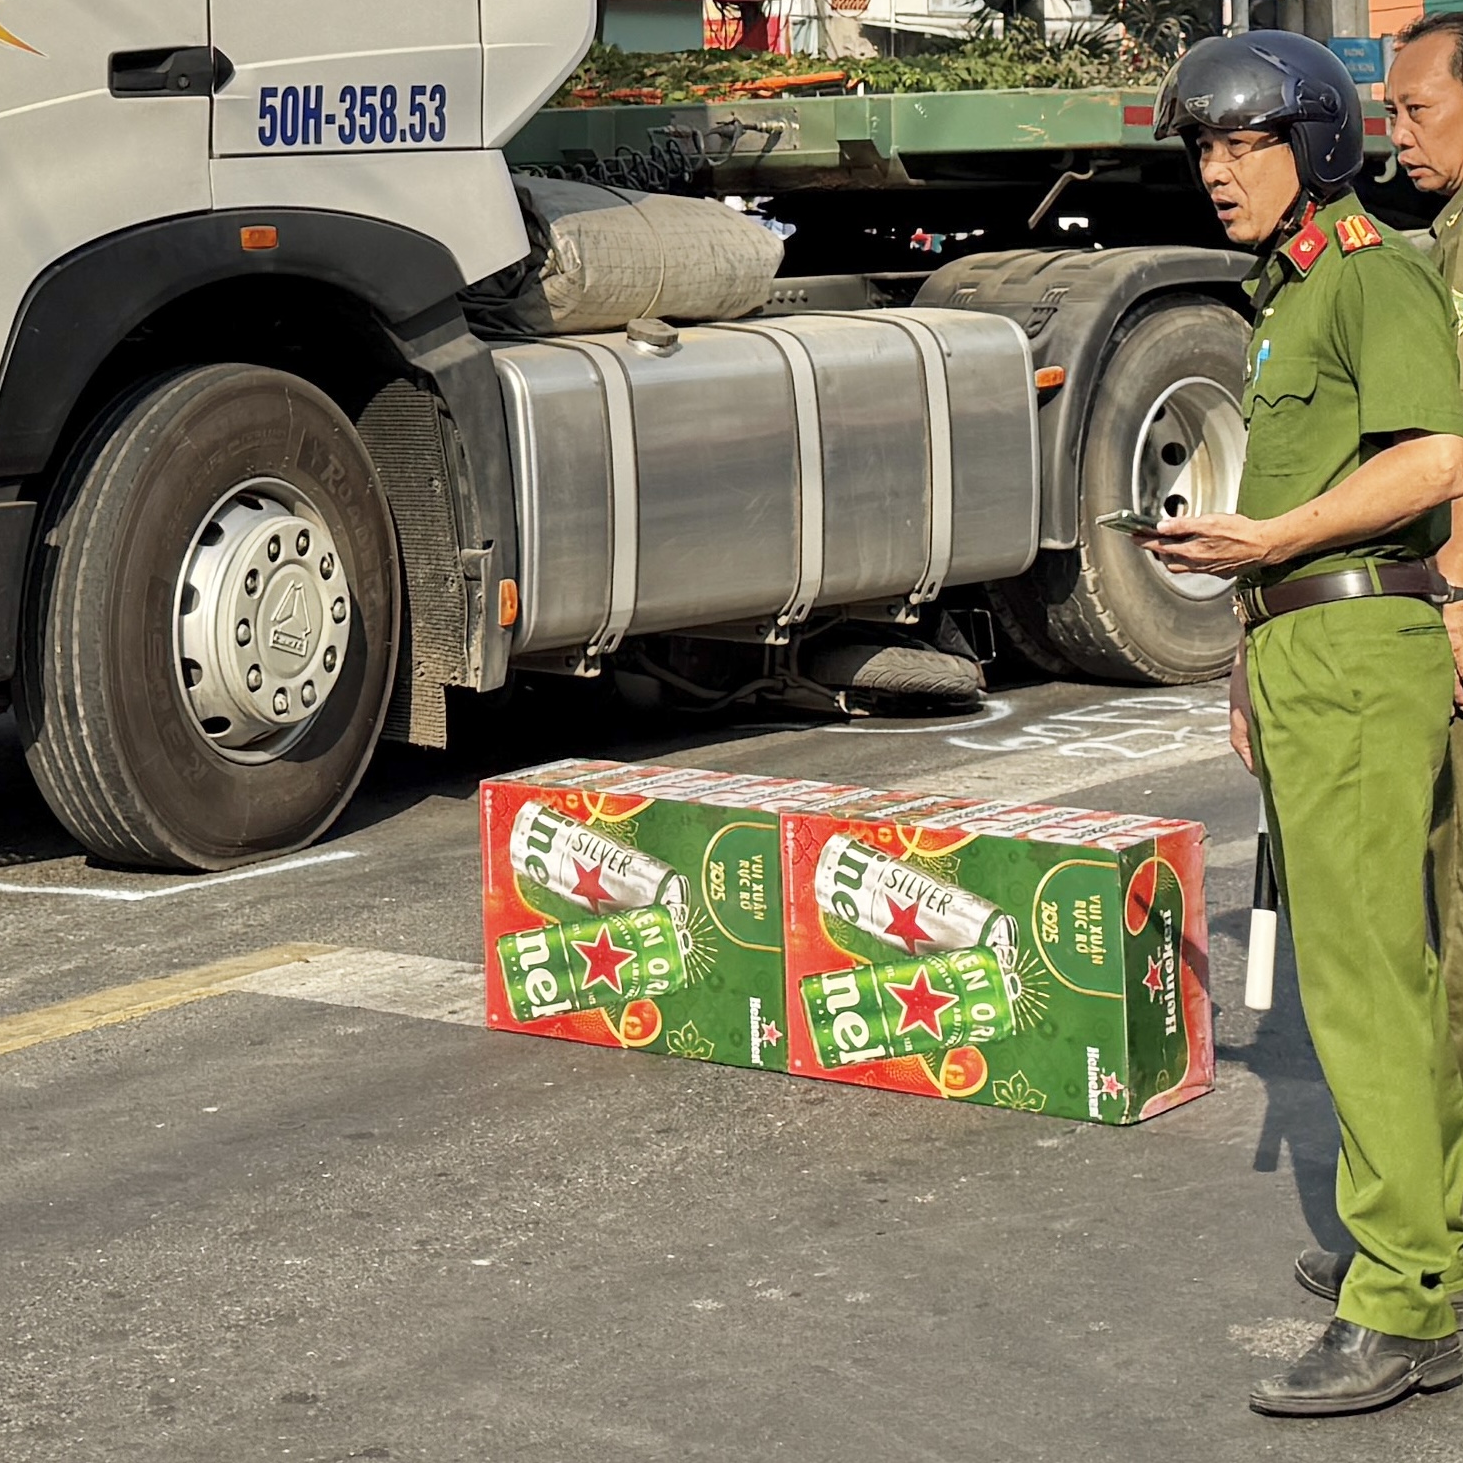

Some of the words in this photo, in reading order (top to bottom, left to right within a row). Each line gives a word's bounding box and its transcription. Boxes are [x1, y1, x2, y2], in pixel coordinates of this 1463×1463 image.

[258, 84, 447, 147] 50H-358.53
[571, 833, 633, 877] SILVER
[752, 854, 764, 879] VUI
[709, 861, 726, 902] 2025
[885, 868, 953, 916] SILVER
[1041, 901, 1059, 944] 2025
[1089, 894, 1101, 921] VUI
[1159, 909, 1178, 1037] Heineken
[749, 996, 764, 1066] Heineken
[1087, 1046, 1103, 1120] Heineken
